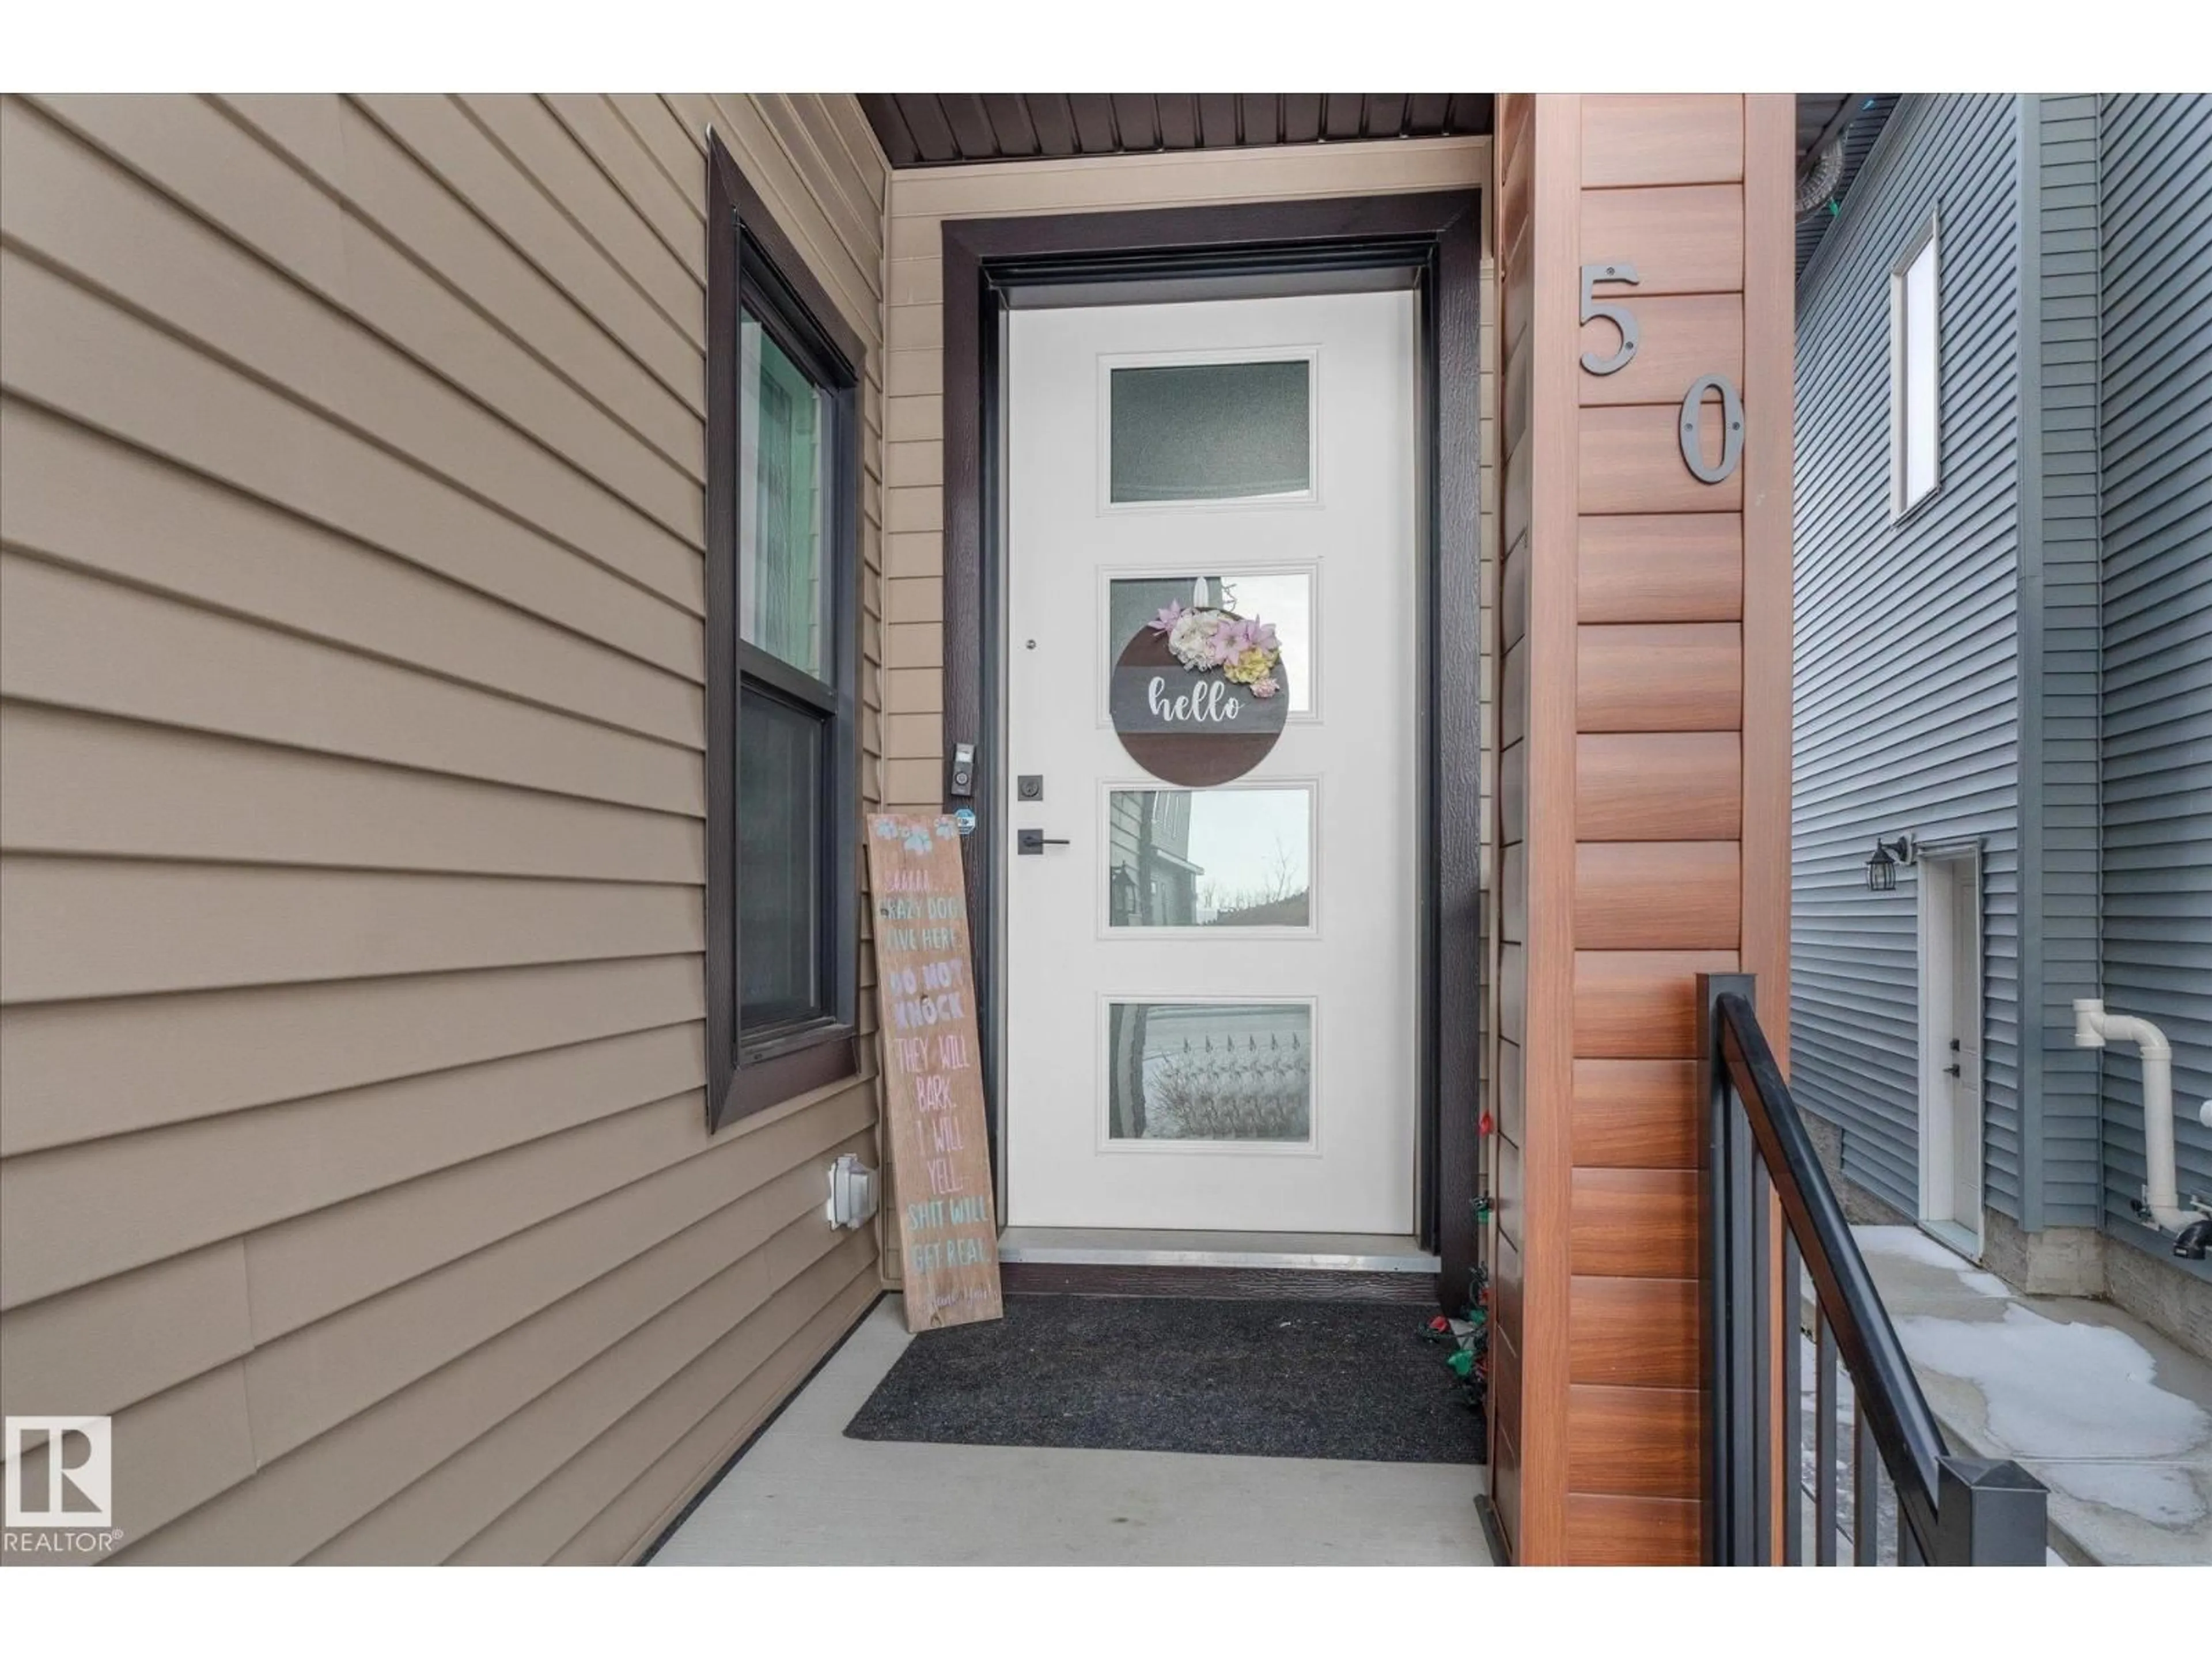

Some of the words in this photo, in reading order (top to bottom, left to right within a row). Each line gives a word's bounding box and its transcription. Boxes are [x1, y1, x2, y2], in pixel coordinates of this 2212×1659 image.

[1580, 264, 1745, 486] 50
[1148, 676, 1245, 722] hello
[889, 965, 917, 995] DO
[922, 958, 964, 991] NOT
[896, 992, 965, 1029] KNOCK
[896, 1036, 929, 1074] THEY
[939, 1032, 970, 1069] WILL
[933, 1115, 964, 1153] WILL
[908, 1200, 944, 1230] SHIT
[949, 1195, 990, 1225] WILL
[910, 1242, 941, 1272] GET
